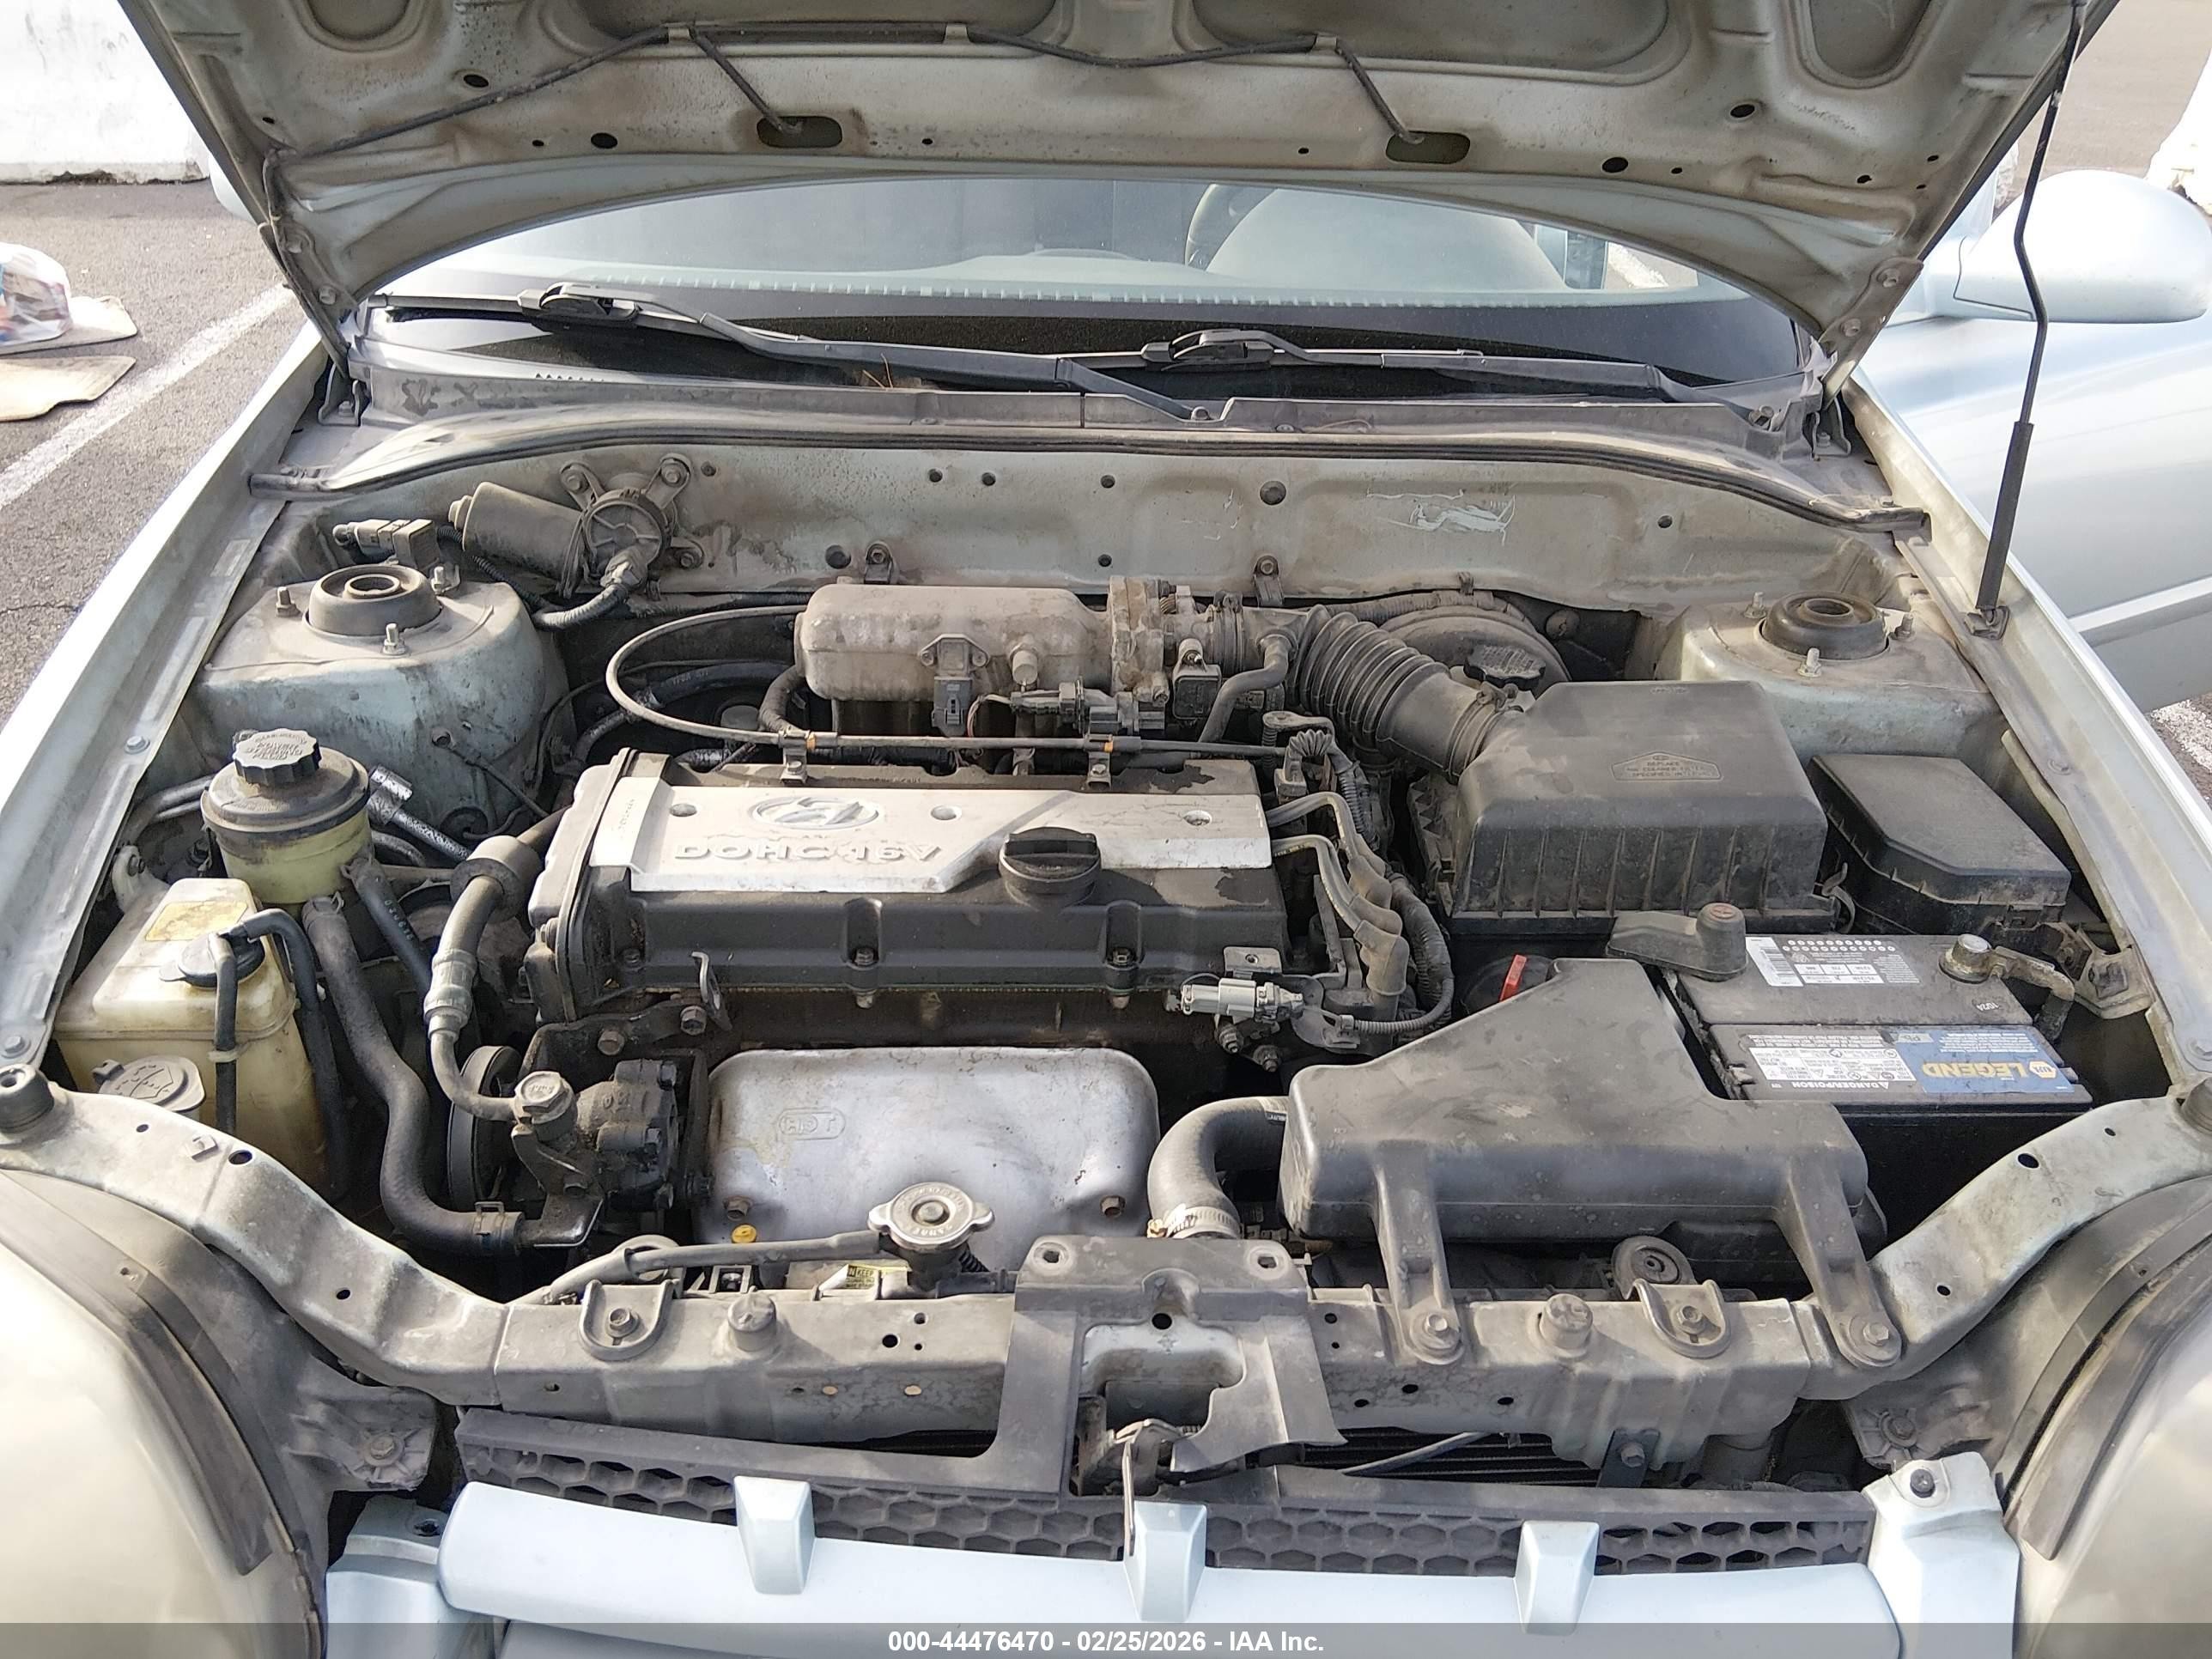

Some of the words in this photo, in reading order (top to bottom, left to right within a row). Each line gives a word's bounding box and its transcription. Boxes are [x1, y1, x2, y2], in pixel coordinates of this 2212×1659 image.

[674, 842, 832, 860] DOHC
[848, 842, 943, 862] 16V
[1923, 1061, 2028, 1079] LEGEND
